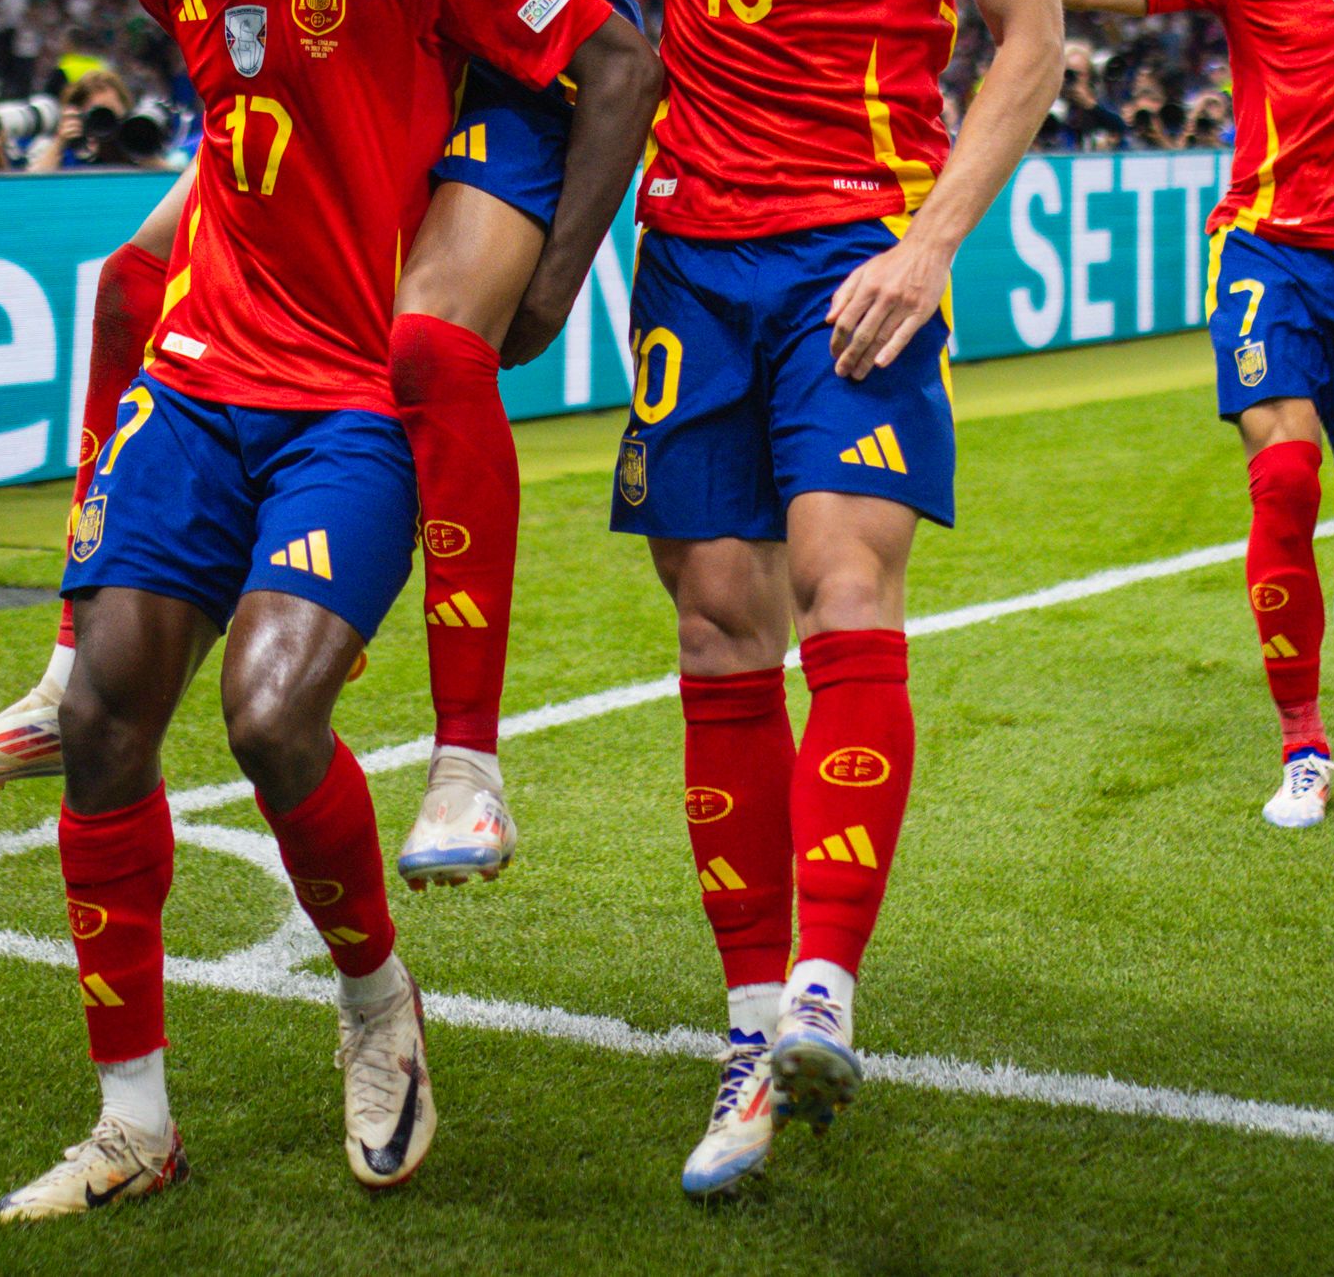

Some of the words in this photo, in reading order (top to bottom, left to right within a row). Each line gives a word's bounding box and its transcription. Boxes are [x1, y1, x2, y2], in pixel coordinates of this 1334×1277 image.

[226, 94, 293, 196] 17
[1229, 279, 1266, 337] 7
[632, 326, 683, 425] 0
[100, 386, 155, 475] 7
